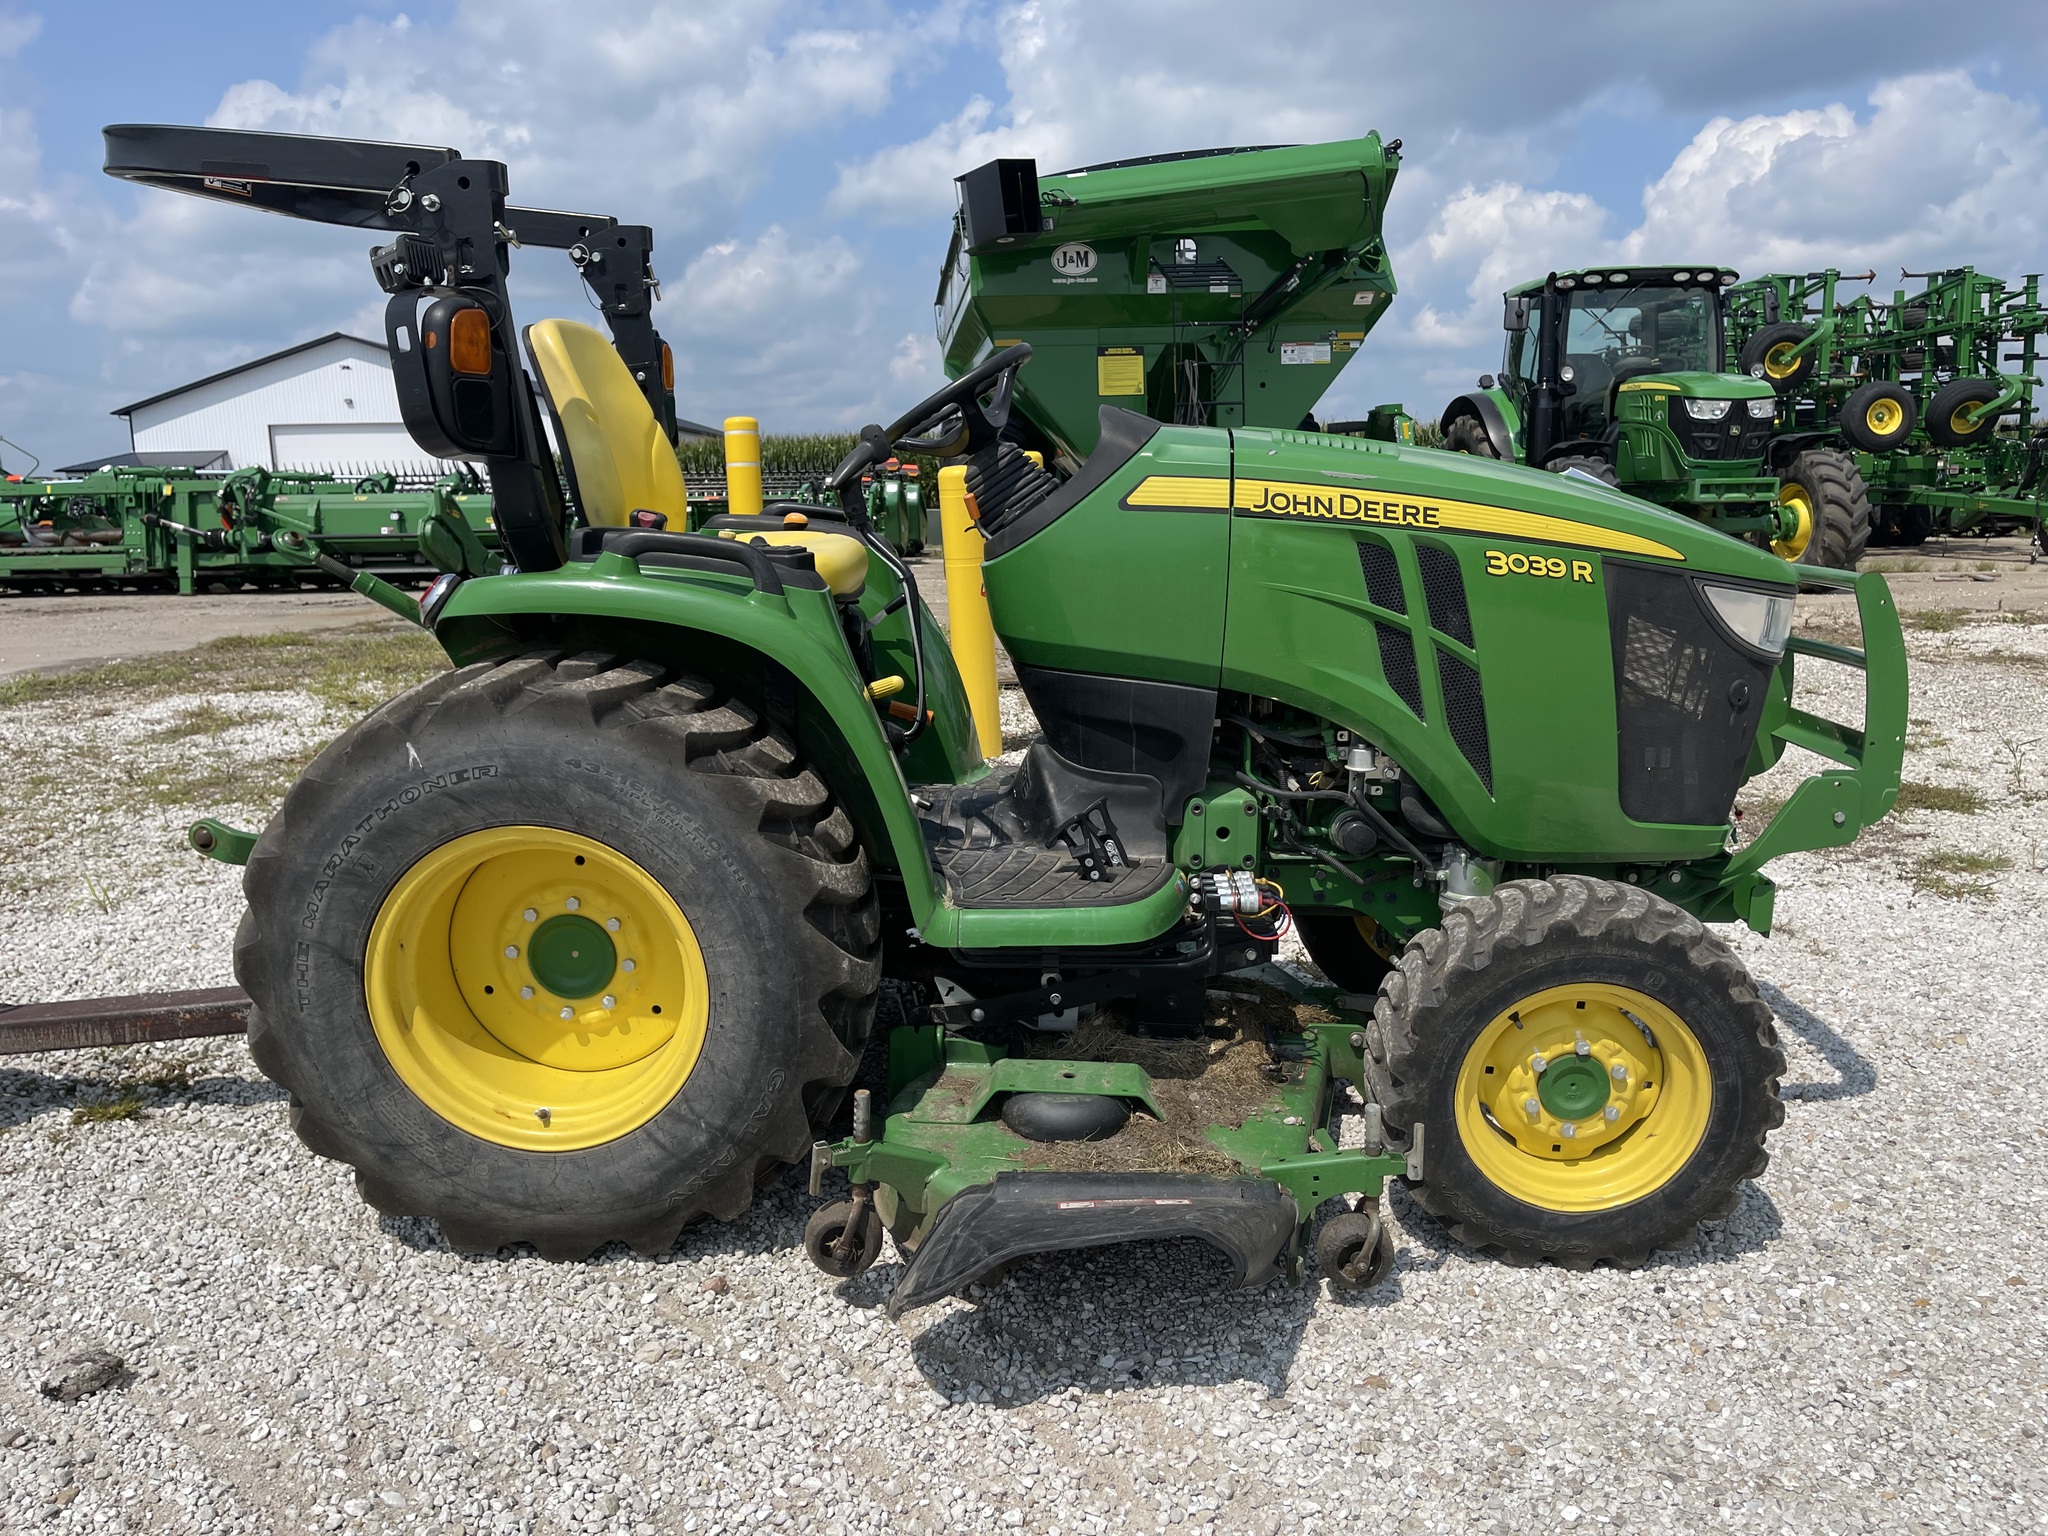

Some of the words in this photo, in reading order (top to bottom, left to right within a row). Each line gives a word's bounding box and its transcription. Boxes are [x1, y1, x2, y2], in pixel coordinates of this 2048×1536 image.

[1056, 250, 1090, 269] J&M
[1253, 488, 1333, 515] JOHN
[1340, 494, 1440, 526] DEERE
[1484, 550, 1567, 578] 3039
[1571, 559, 1595, 584] R
[302, 764, 498, 929] MARATHONER
[296, 941, 310, 1012] THE
[667, 1067, 787, 1207] GALAXY
[1443, 1190, 1591, 1254] GALAXY
